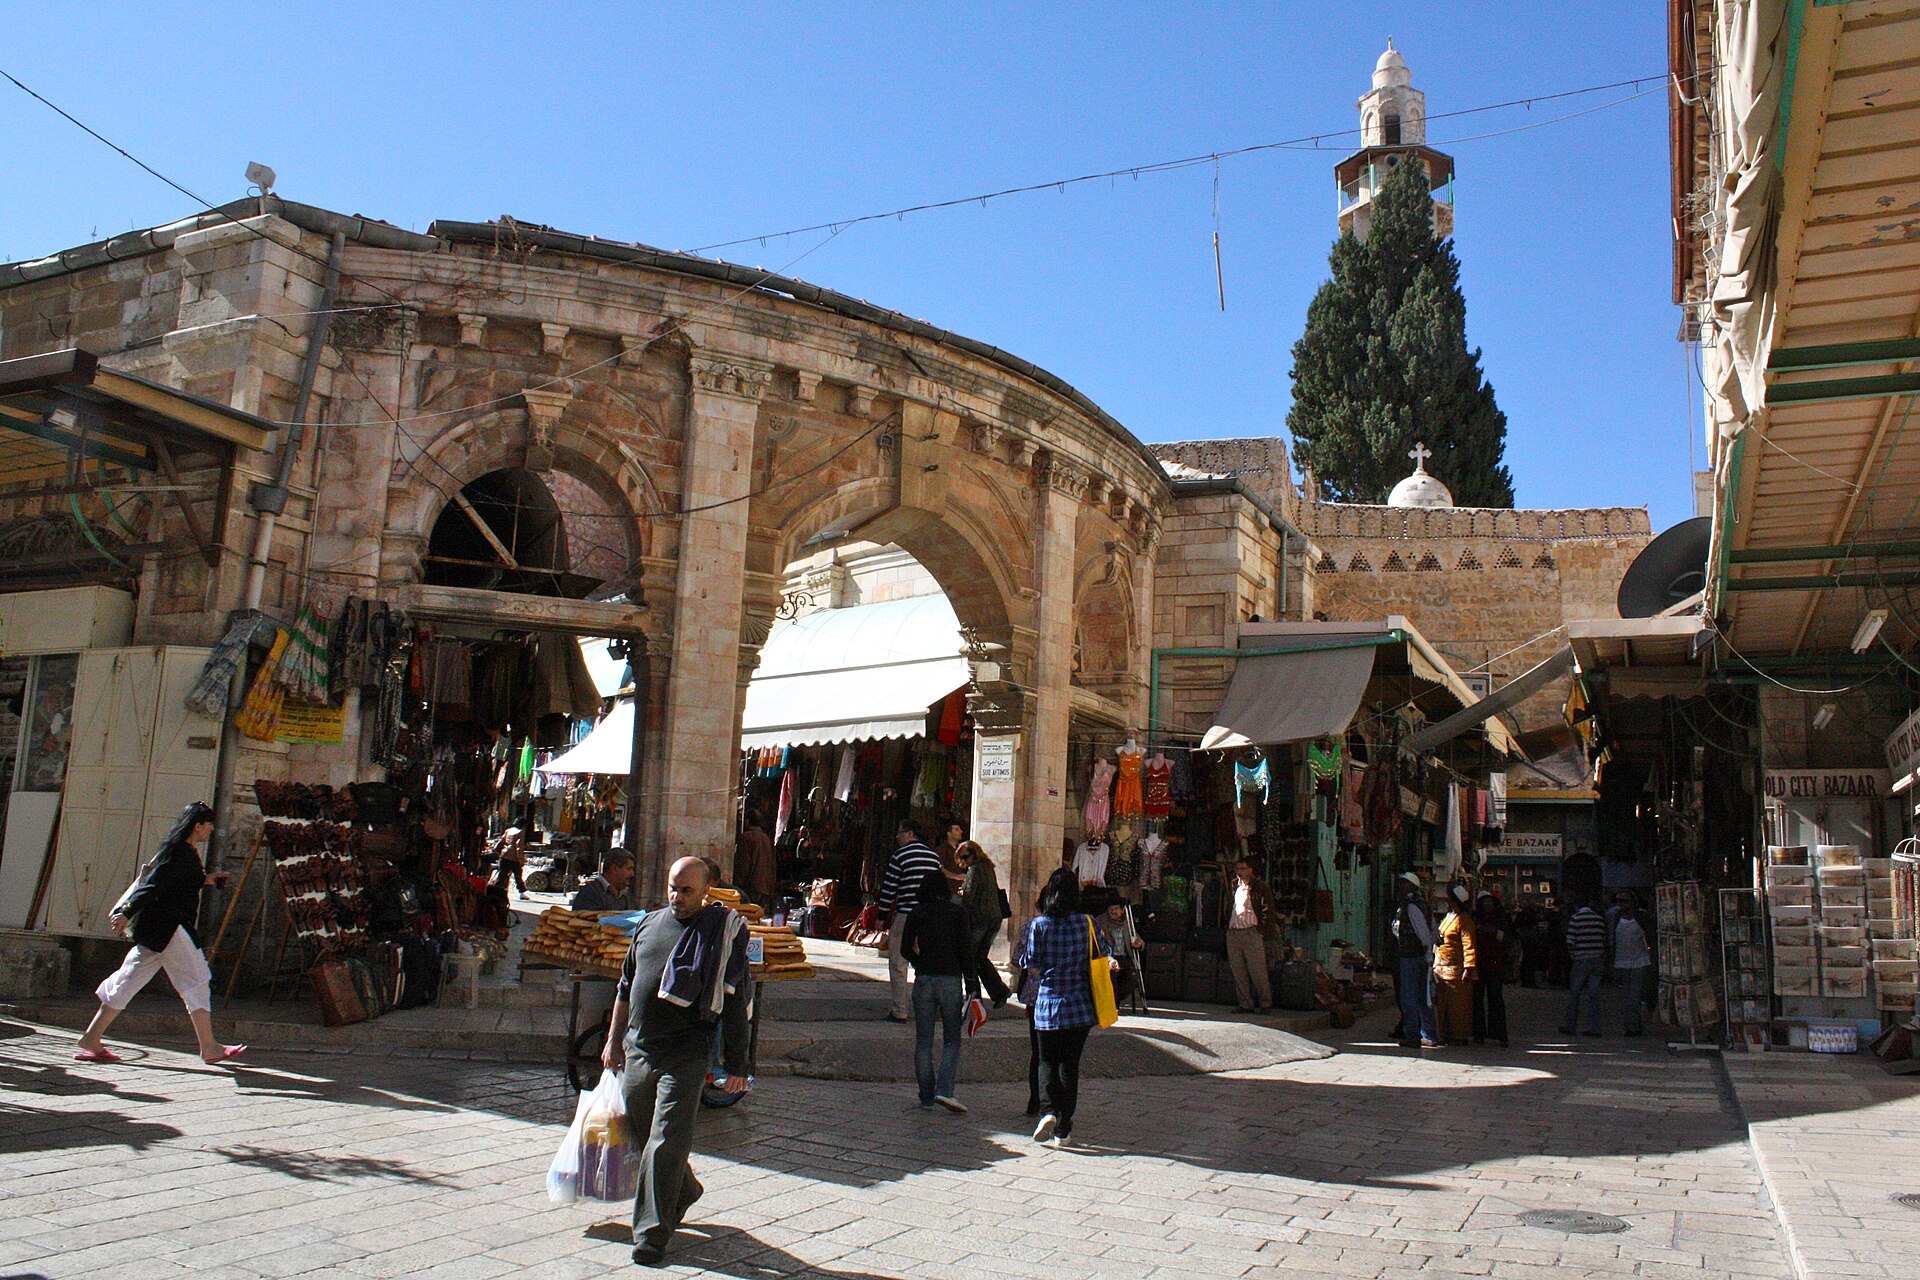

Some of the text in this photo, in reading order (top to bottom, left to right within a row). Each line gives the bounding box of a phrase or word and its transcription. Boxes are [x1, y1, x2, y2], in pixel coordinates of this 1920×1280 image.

[1765, 775, 1878, 797] OLD CITY BAZAAR
[1517, 838, 1559, 847] BAZAAR
